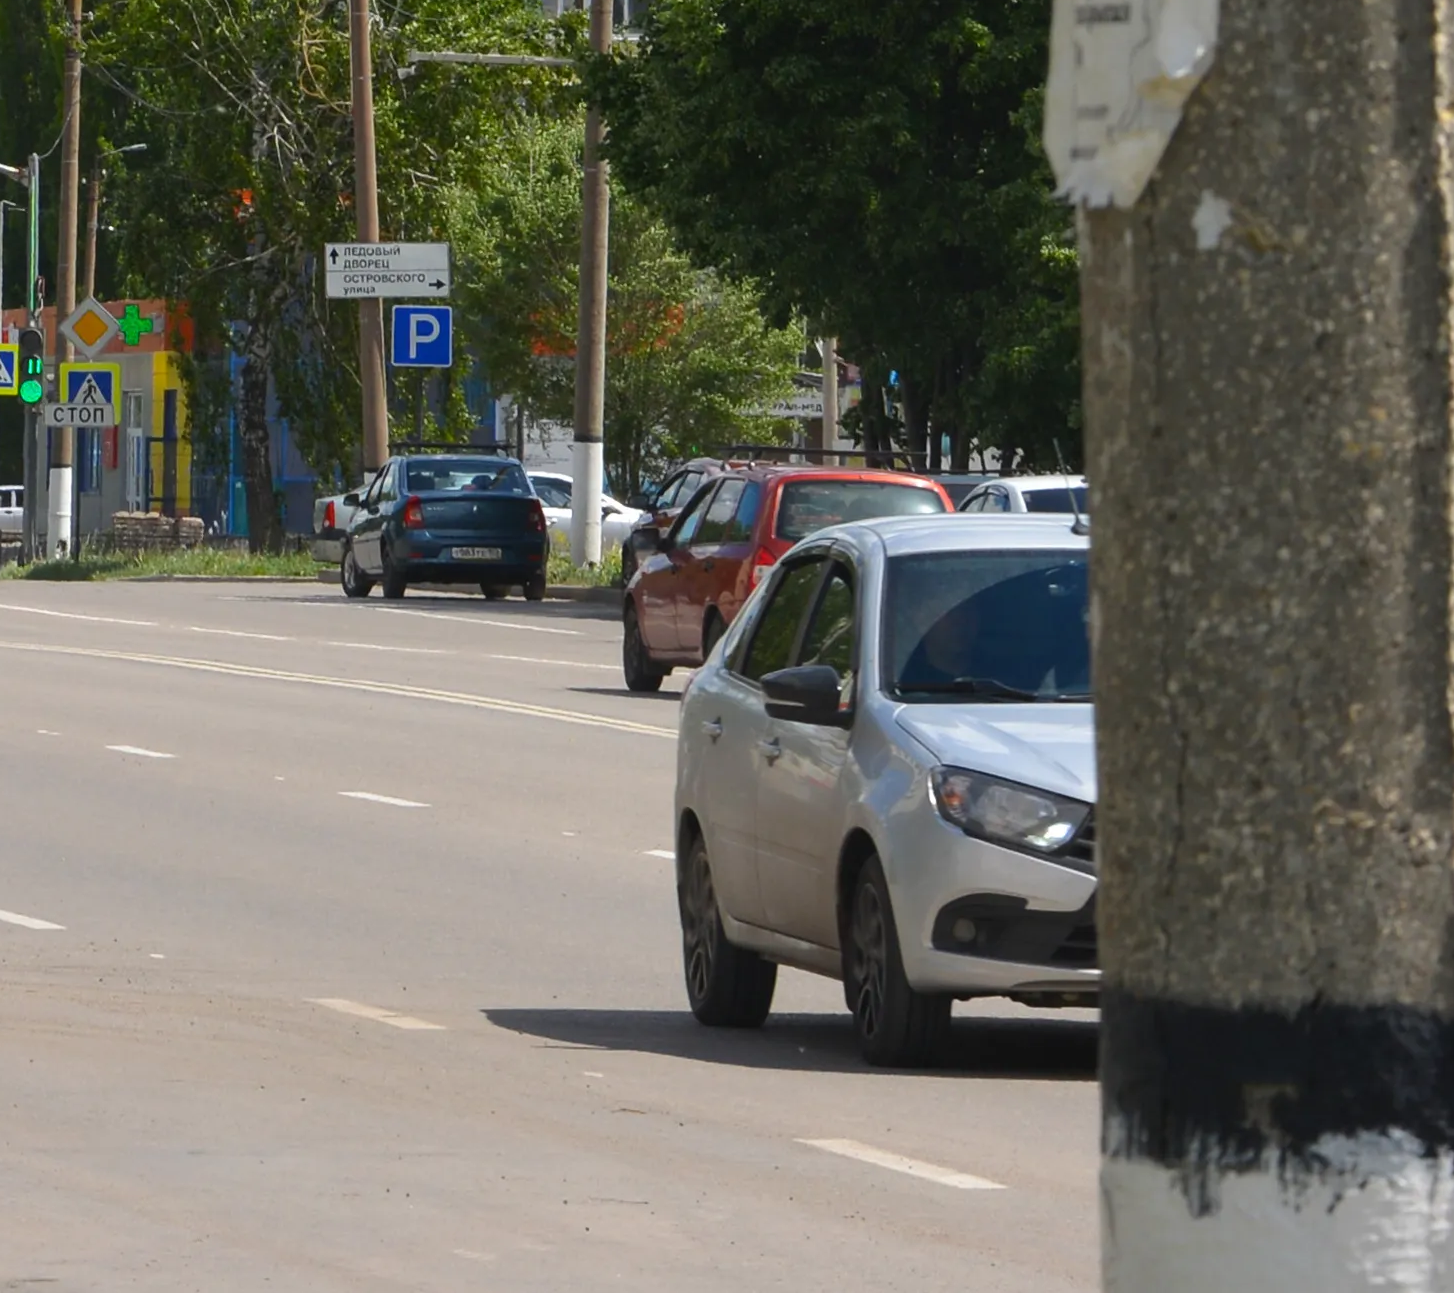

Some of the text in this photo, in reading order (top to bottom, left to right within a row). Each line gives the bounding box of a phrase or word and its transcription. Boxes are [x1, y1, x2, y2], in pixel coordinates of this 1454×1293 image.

[343, 259, 390, 270] ДВОРЕЦ
[343, 273, 426, 283] ОСТРОВСКОГО
[343, 287, 376, 295] улица
[409, 314, 441, 359] P
[53, 407, 104, 423] СТОП
